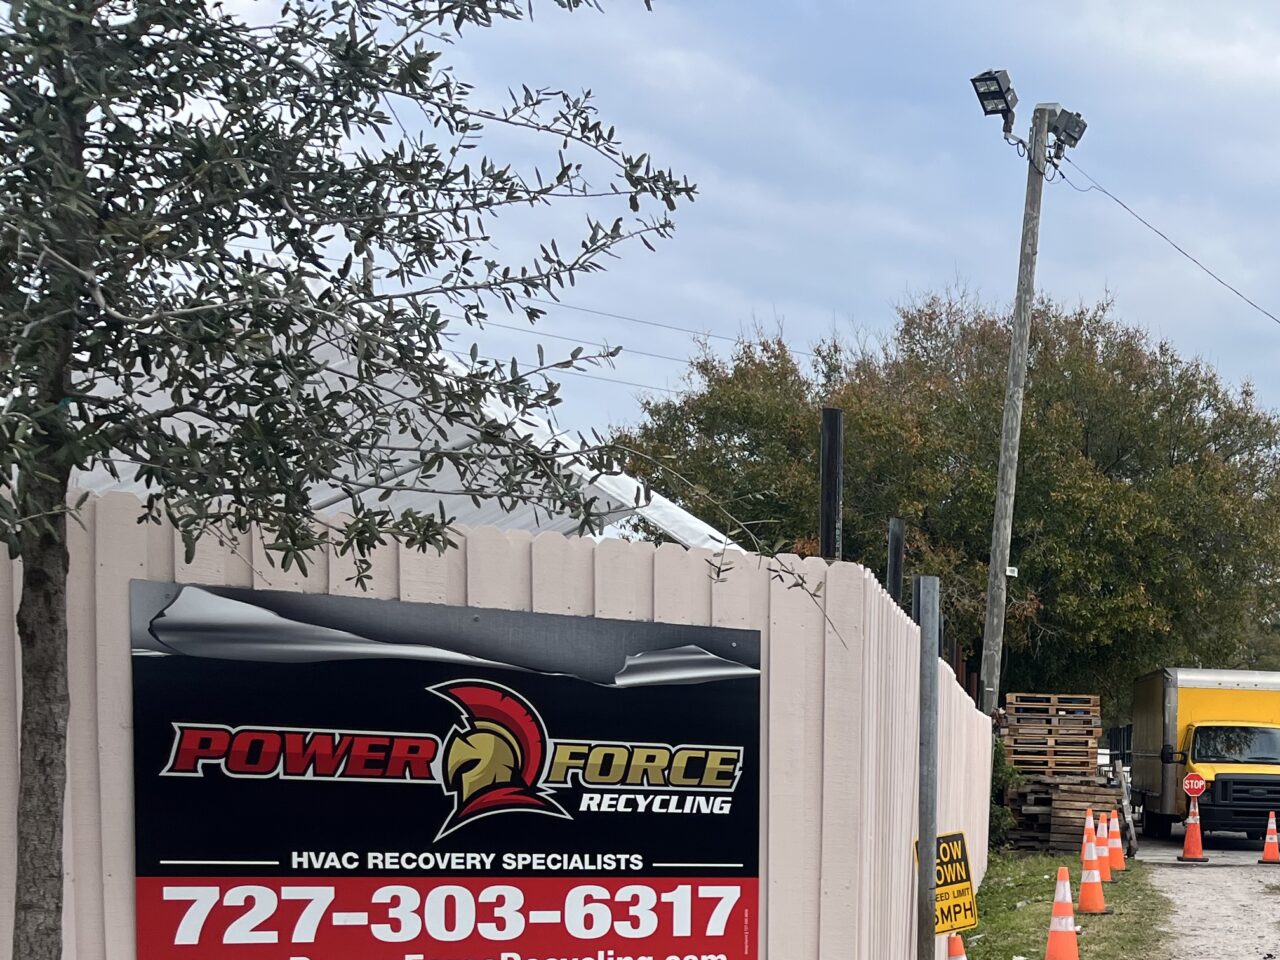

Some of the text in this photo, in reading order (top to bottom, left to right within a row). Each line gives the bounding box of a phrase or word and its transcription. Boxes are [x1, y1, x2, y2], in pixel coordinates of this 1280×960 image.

[164, 726, 742, 790] POWER FORCE
[1184, 779, 1205, 789] STOP
[579, 793, 732, 815] RECYCLING
[291, 851, 644, 871] HVAC RECOVERY SPECIALISTS
[936, 840, 963, 864] OW
[936, 861, 967, 885] OWN
[936, 887, 971, 903] EED LIMIT
[162, 884, 741, 945] 727-303-6317
